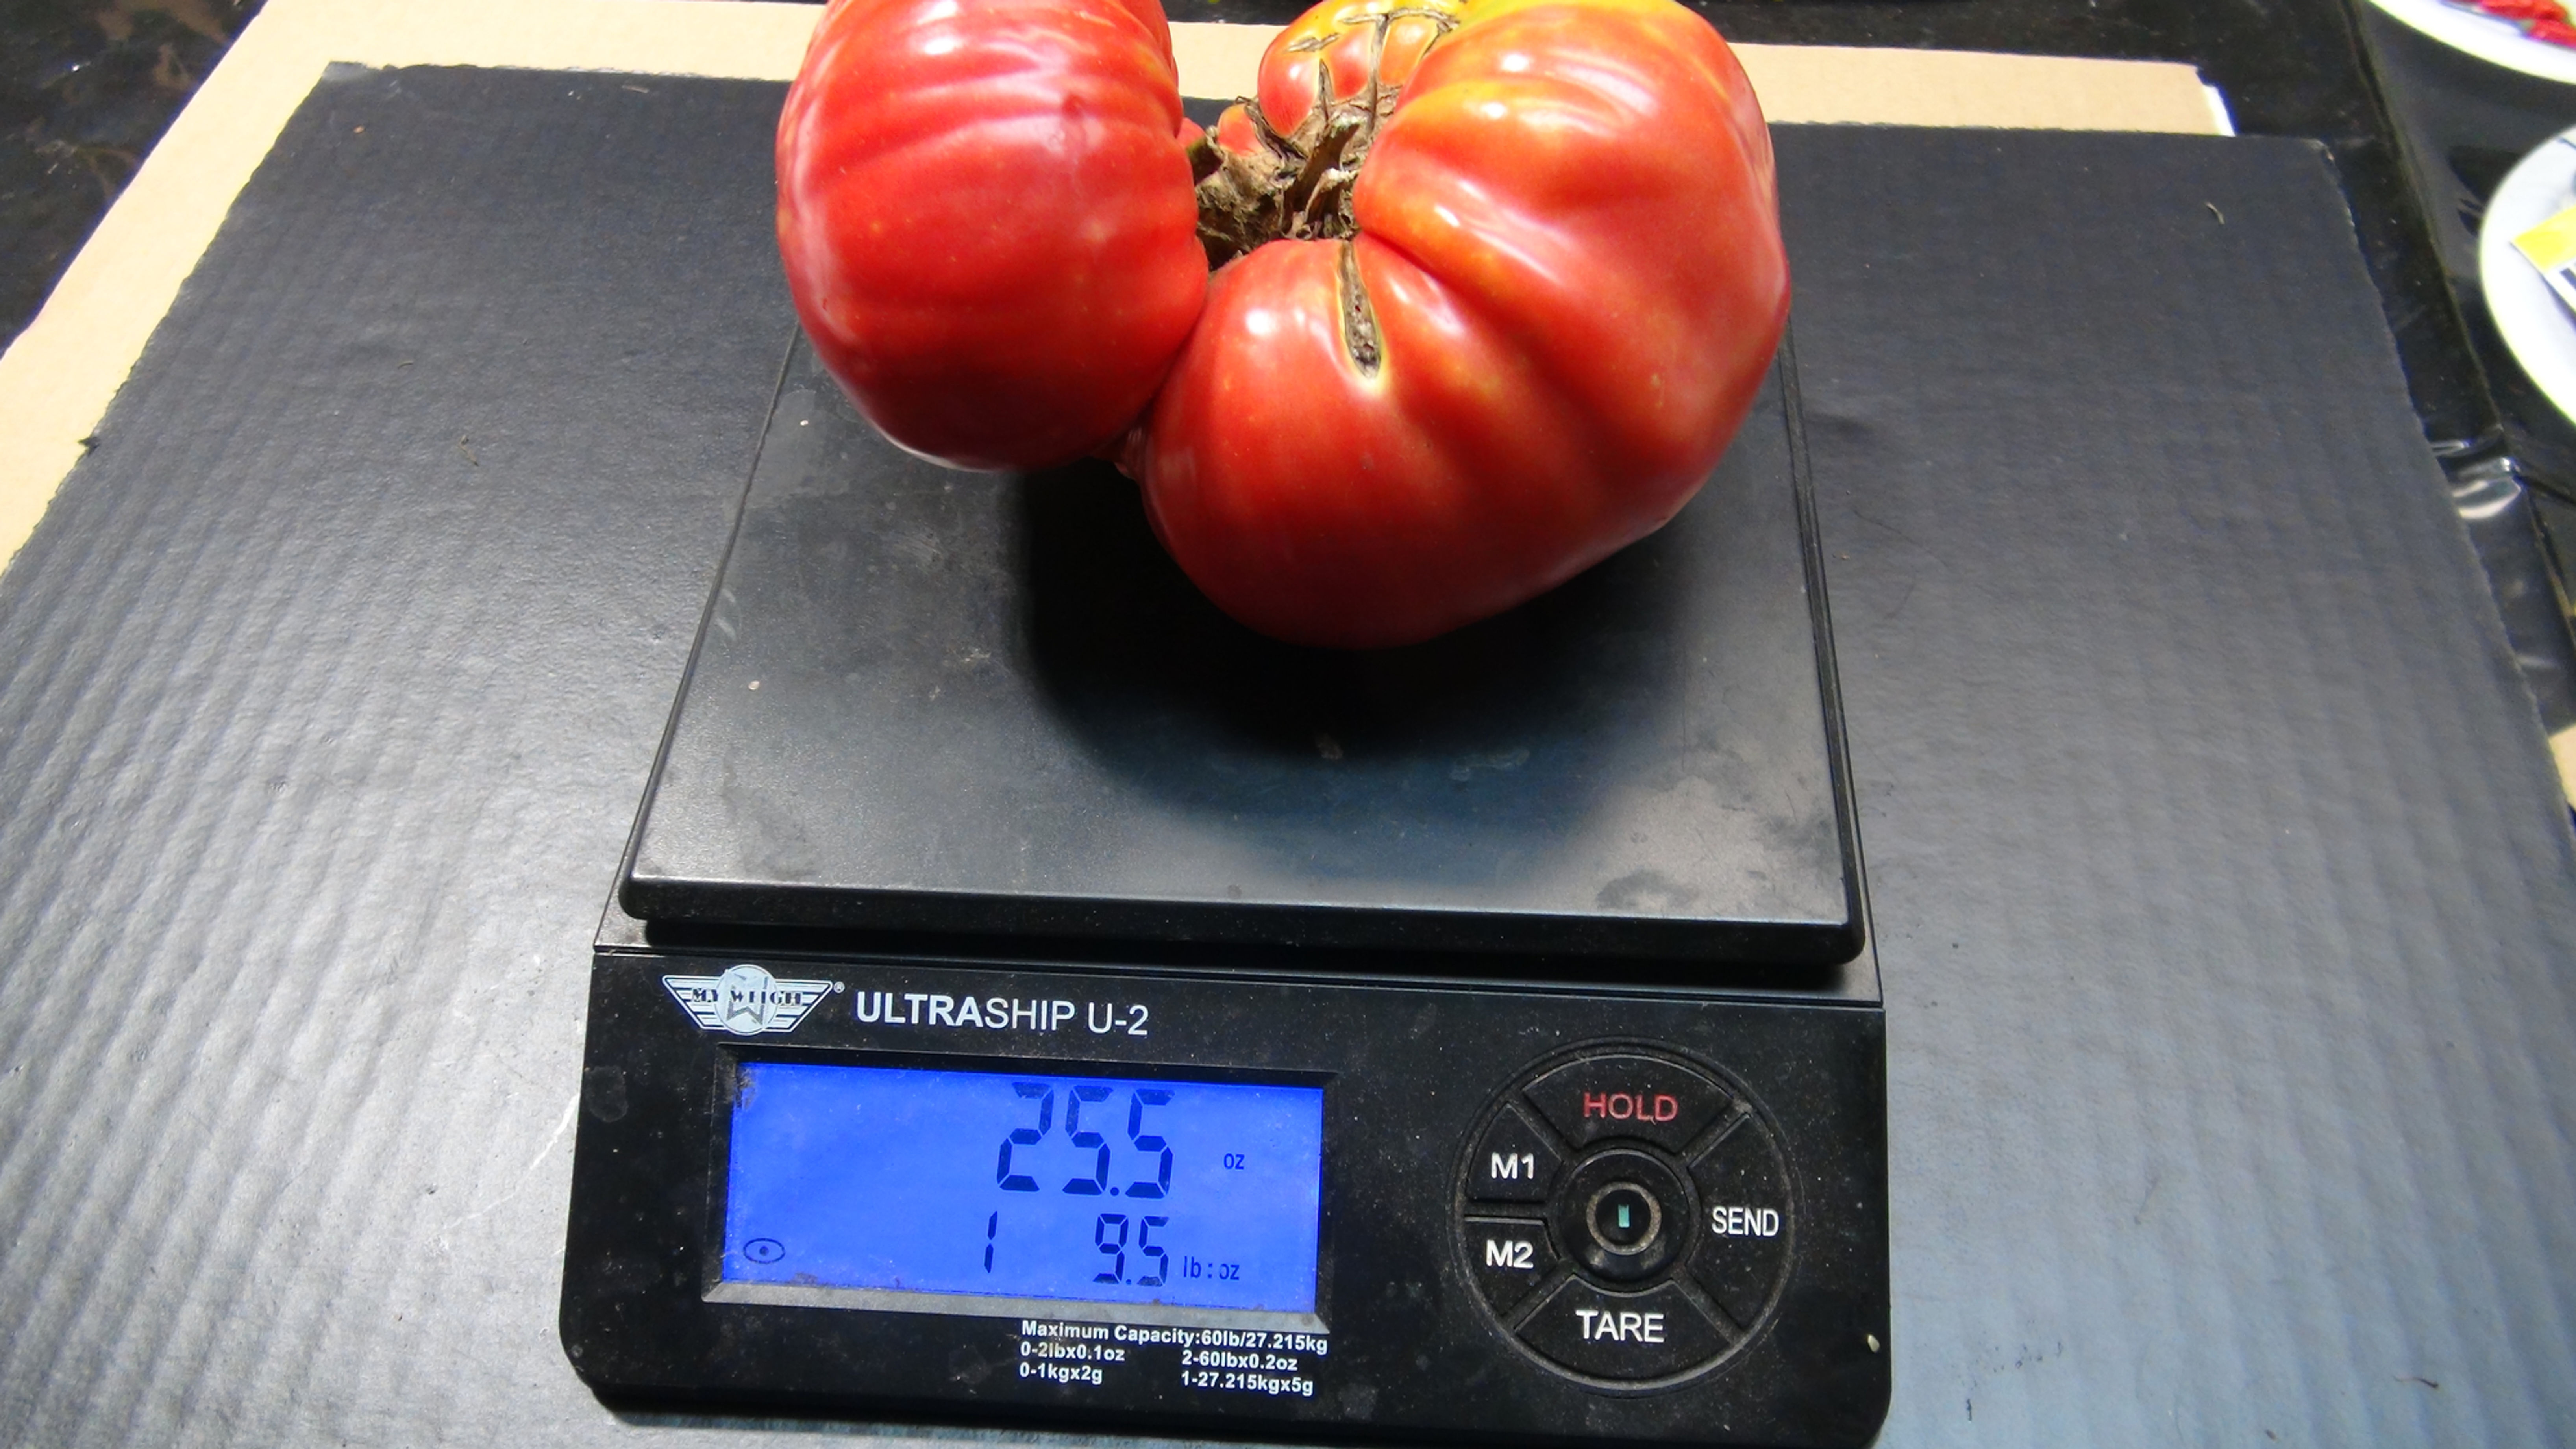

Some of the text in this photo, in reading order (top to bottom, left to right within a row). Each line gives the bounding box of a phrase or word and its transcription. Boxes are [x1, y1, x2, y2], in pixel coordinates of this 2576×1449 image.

[856, 991, 1148, 1036] ULTRASHIP U-2
[1583, 1092, 1678, 1122] HOLD
[997, 1082, 1245, 1199] 25.5 oz
[1491, 1153, 1534, 1180] M1
[1711, 1206, 1779, 1237] SEND
[984, 1210, 998, 1274] 1
[1093, 1213, 1169, 1287] 9.5
[1486, 1240, 1534, 1269] M2
[1022, 1320, 1328, 1355] Maximum Capacity:60lb/27.215kg
[1576, 1310, 1665, 1343] TARE
[1021, 1342, 1125, 1362] 0-2lbx0.1oz
[1182, 1350, 1298, 1372] 2-60lbx0.2oz
[1019, 1362, 1103, 1386] 0-1kgx2g
[1181, 1371, 1314, 1396] 1-27.215kgx5g
